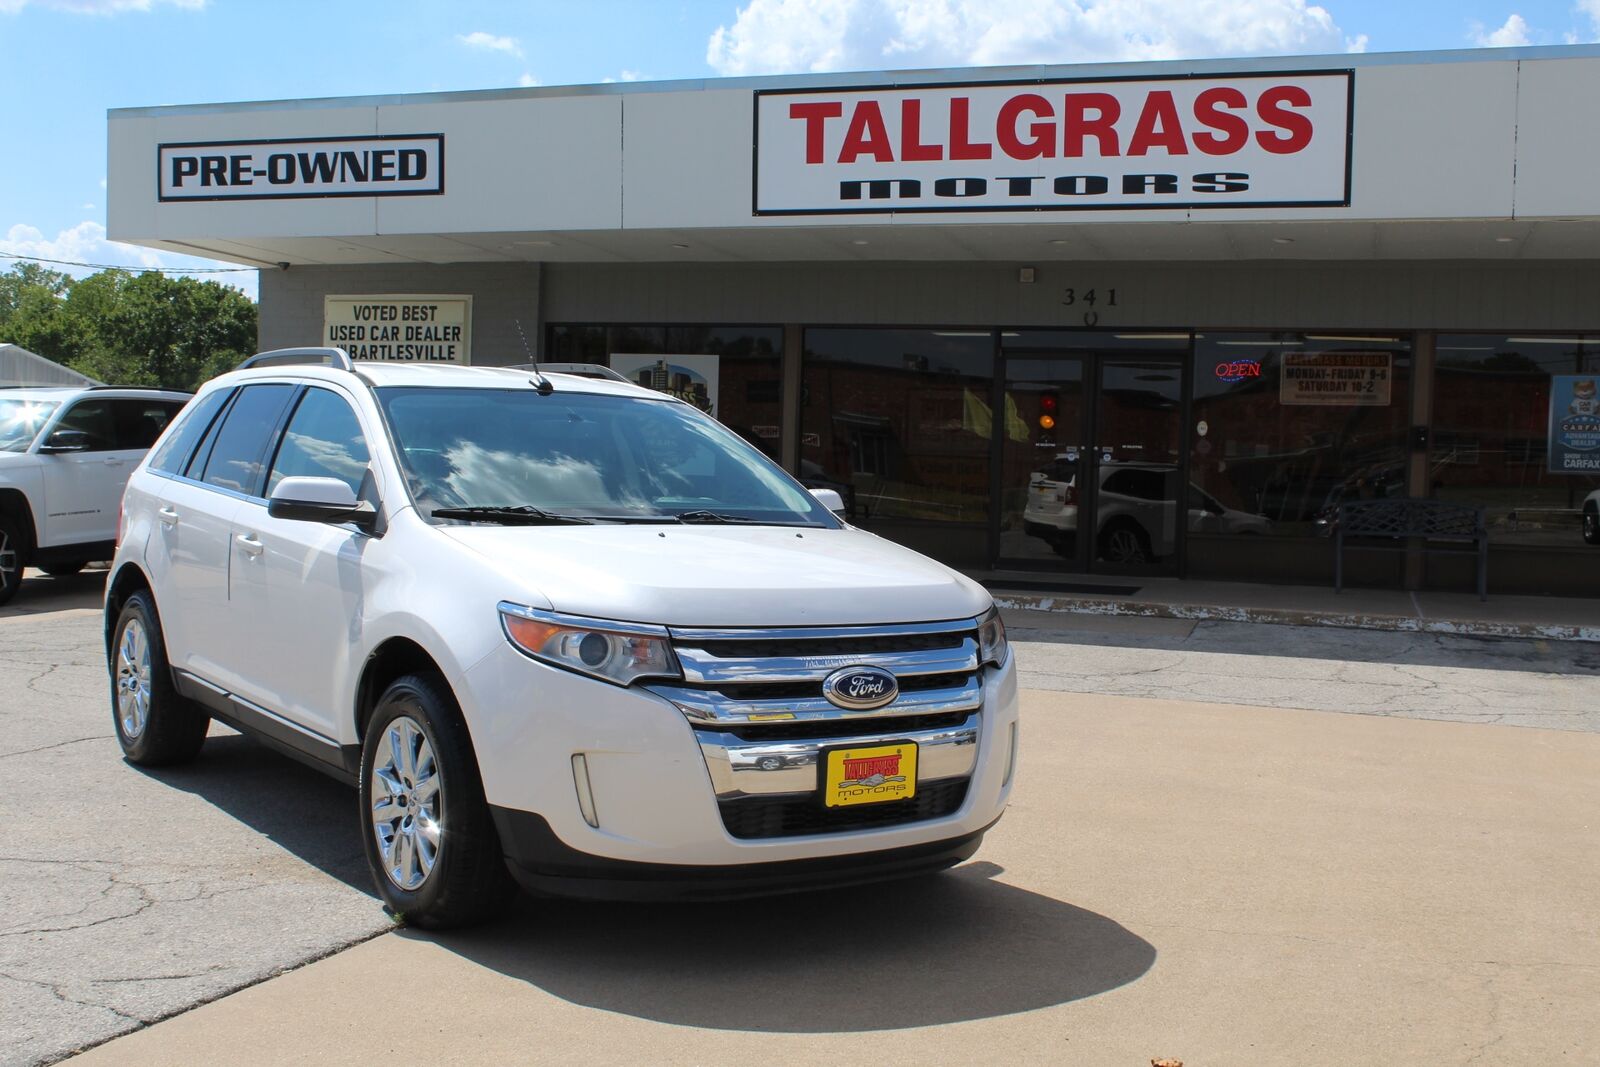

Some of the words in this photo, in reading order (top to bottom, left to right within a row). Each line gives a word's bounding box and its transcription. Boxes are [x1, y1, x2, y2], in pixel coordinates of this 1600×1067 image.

[789, 85, 1313, 164] TALLGRASS
[172, 148, 427, 187] PRE-OWNED
[840, 173, 1249, 200] MOTORS
[1061, 288, 1117, 306] 341
[353, 305, 397, 321] VOTED
[402, 305, 438, 321] BEST
[330, 325, 365, 341] USED
[370, 325, 399, 341] CAR
[405, 326, 461, 341] DEALER
[349, 344, 455, 360] BARTLESVILLE
[1215, 362, 1261, 377] OPEN
[1286, 367, 1366, 379] MONDAY-FRIDAY
[1298, 380, 1347, 392] SATURDAY
[1352, 381, 1375, 393] 10-2
[1564, 459, 1600, 468] CARFAX
[849, 675, 884, 697] Ford
[842, 754, 902, 781] TALLGRASS
[838, 783, 906, 798] MOTORS
